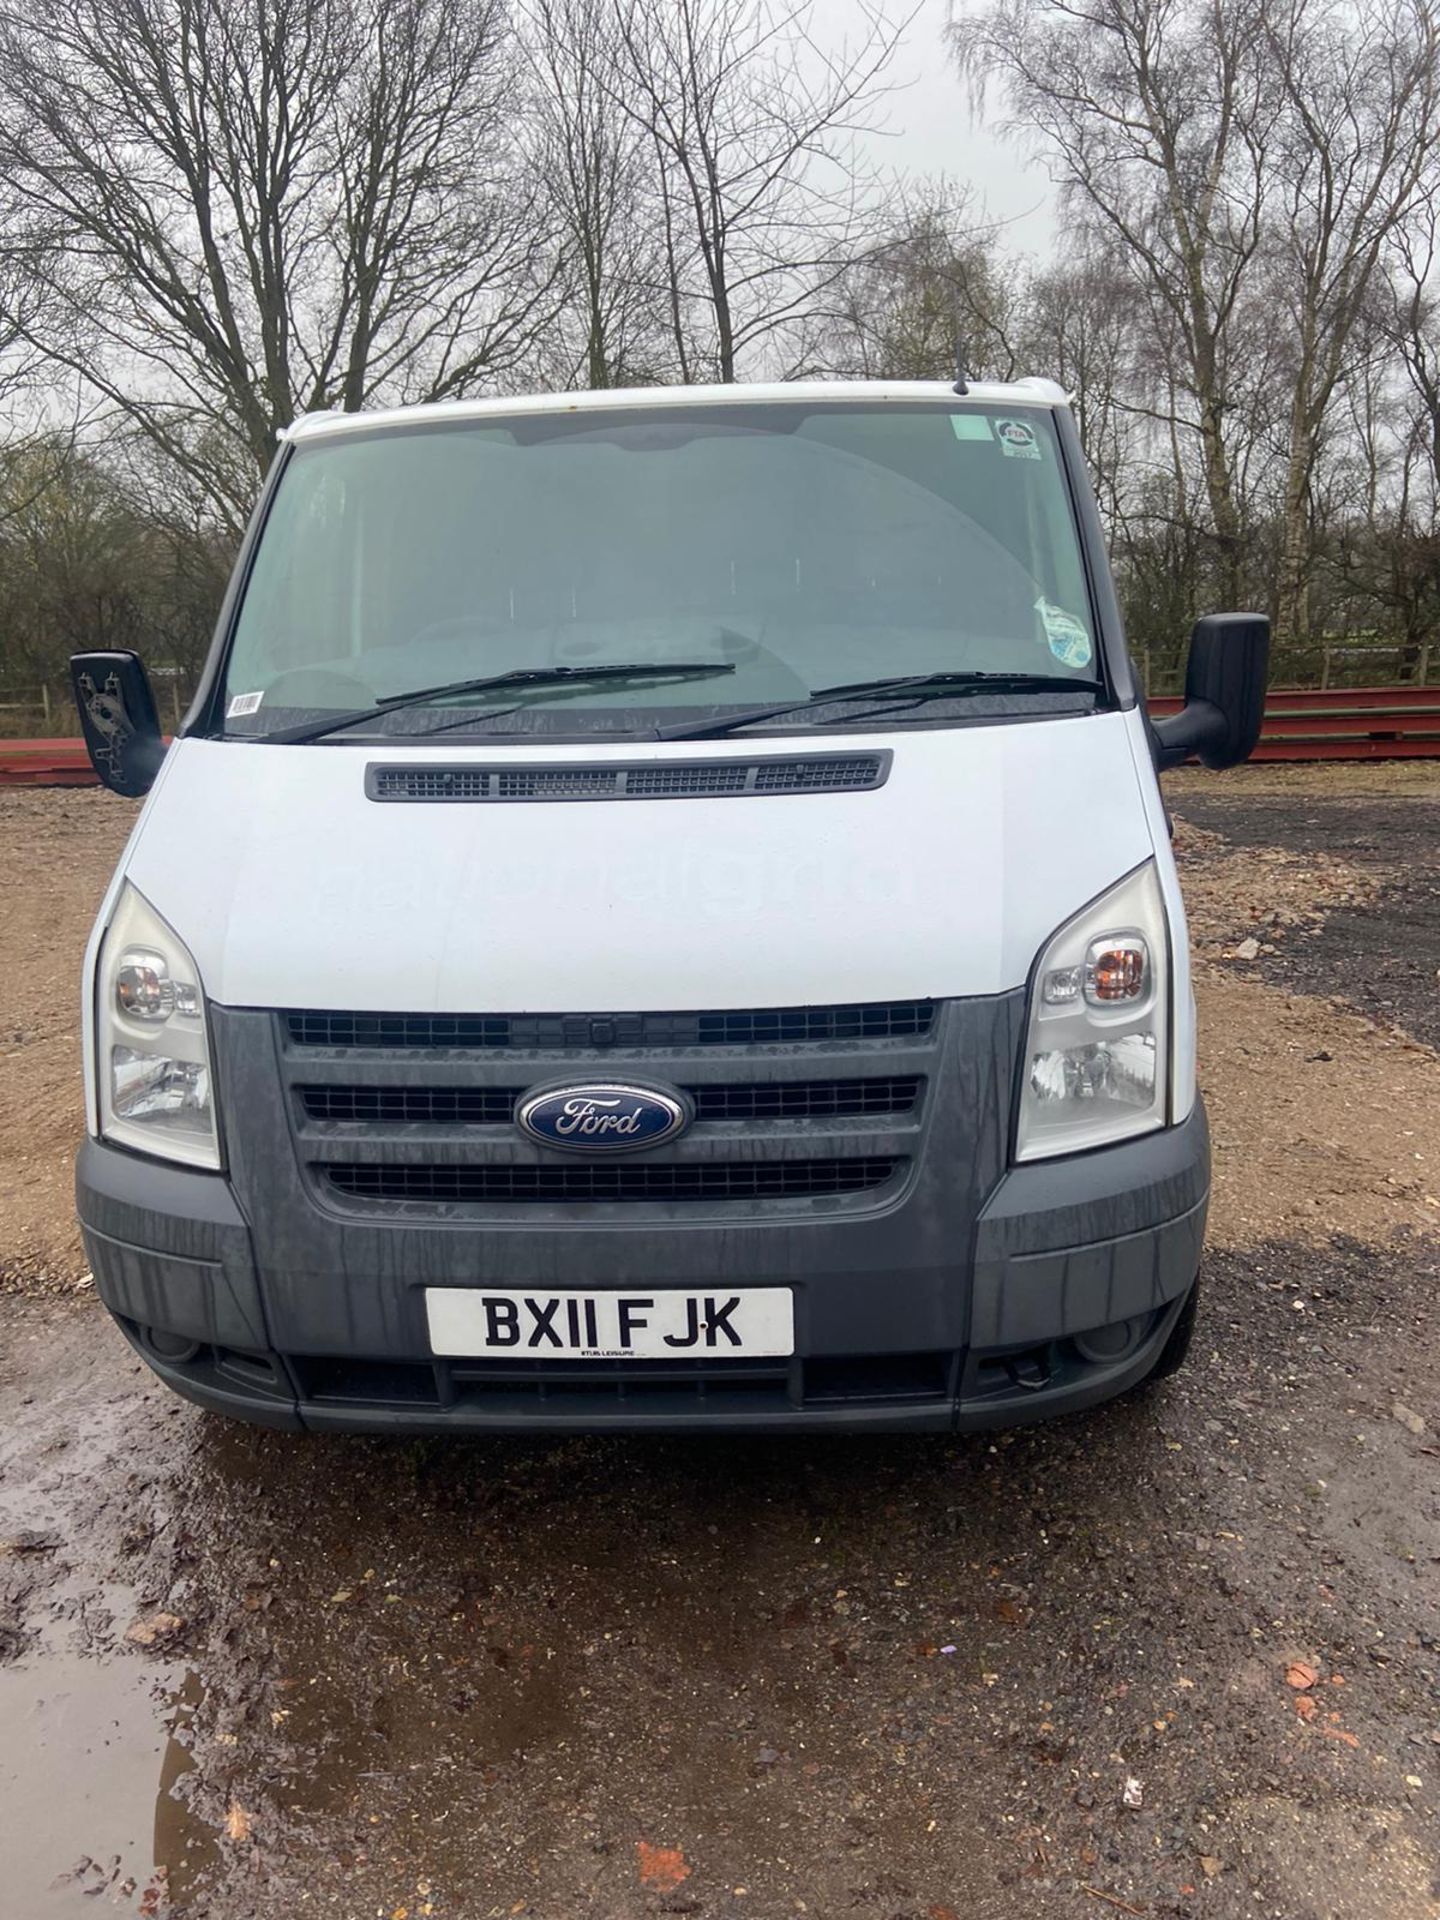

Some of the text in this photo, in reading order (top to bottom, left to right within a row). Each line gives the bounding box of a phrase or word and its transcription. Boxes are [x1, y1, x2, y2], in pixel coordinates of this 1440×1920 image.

[556, 1098, 642, 1135] Ford
[482, 1296, 743, 1348] BX11 FJK
